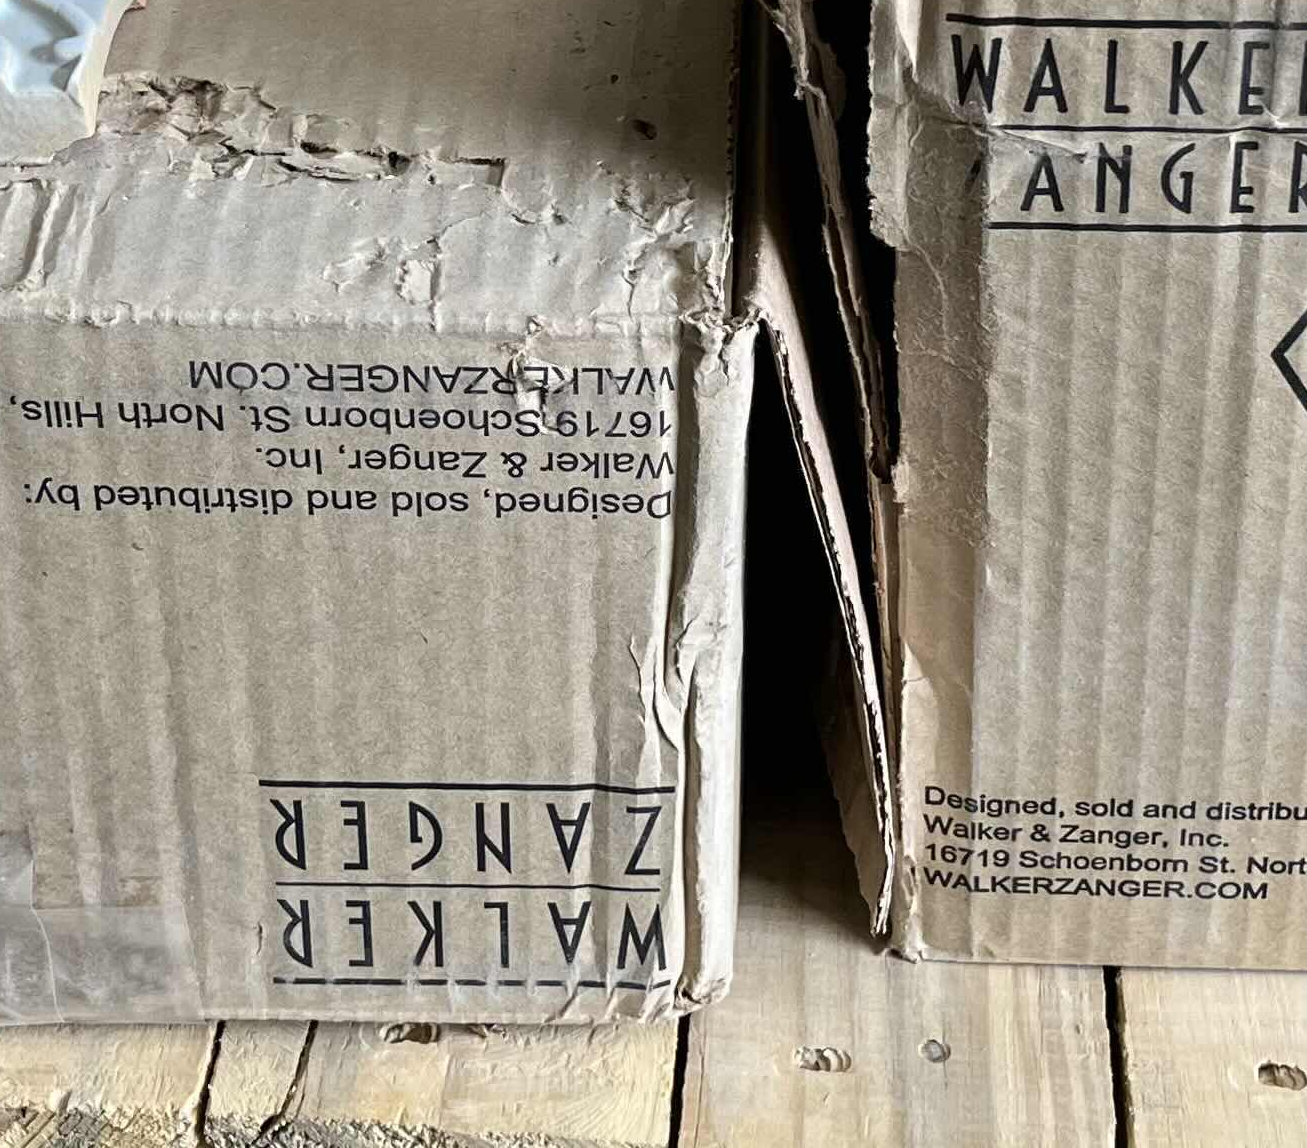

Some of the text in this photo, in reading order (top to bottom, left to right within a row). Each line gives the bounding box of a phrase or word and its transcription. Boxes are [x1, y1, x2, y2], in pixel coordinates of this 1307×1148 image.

[190, 361, 675, 395] WALKERZANGER.COM
[10, 395, 104, 428] Hills,
[118, 402, 225, 431] North
[240, 405, 291, 433] St.
[306, 406, 542, 436] Schoenborn
[557, 411, 672, 437] 16719
[257, 443, 675, 479] Walker & Zanger, Inc.
[23, 477, 672, 519] Designed, sold and distributed by:
[924, 786, 1065, 818] Designed,
[1075, 798, 1134, 818] sold
[1143, 801, 1195, 819] and
[269, 800, 662, 876] ZANGER
[923, 814, 1229, 849] Walker & Zanger, Inc.
[925, 843, 1010, 868] 16719
[1019, 850, 1188, 873] Schoenborn
[1198, 856, 1235, 874] St.
[923, 866, 1268, 899] WALKERZANGER.COM
[276, 899, 668, 971] WALKER
